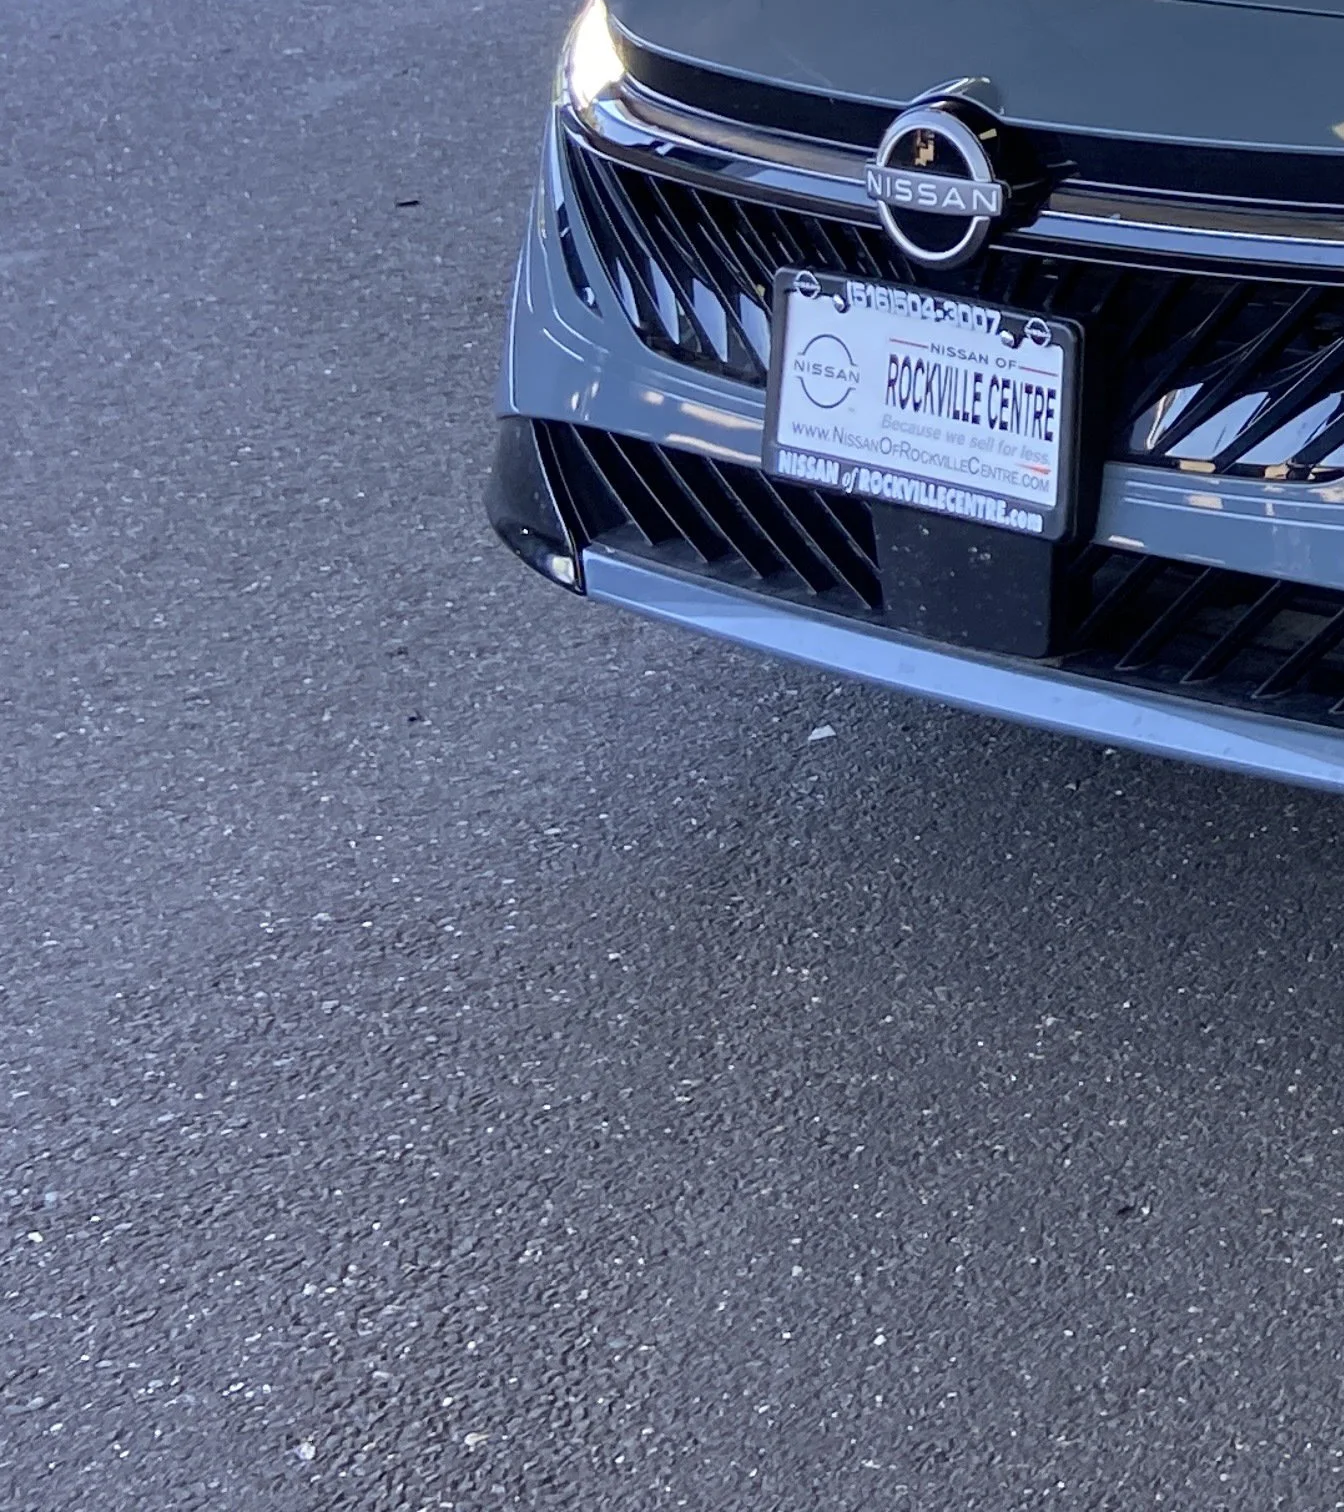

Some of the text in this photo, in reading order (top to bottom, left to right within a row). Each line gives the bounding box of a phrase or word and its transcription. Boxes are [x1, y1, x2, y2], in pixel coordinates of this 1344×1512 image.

[866, 170, 997, 213] NISSAN
[793, 359, 860, 384] NISSAN
[930, 343, 1019, 370] NISSAN OF
[885, 353, 1057, 442] ROCKVILLE CENTRE
[881, 414, 942, 439] Because
[778, 449, 840, 485] NISSAN
